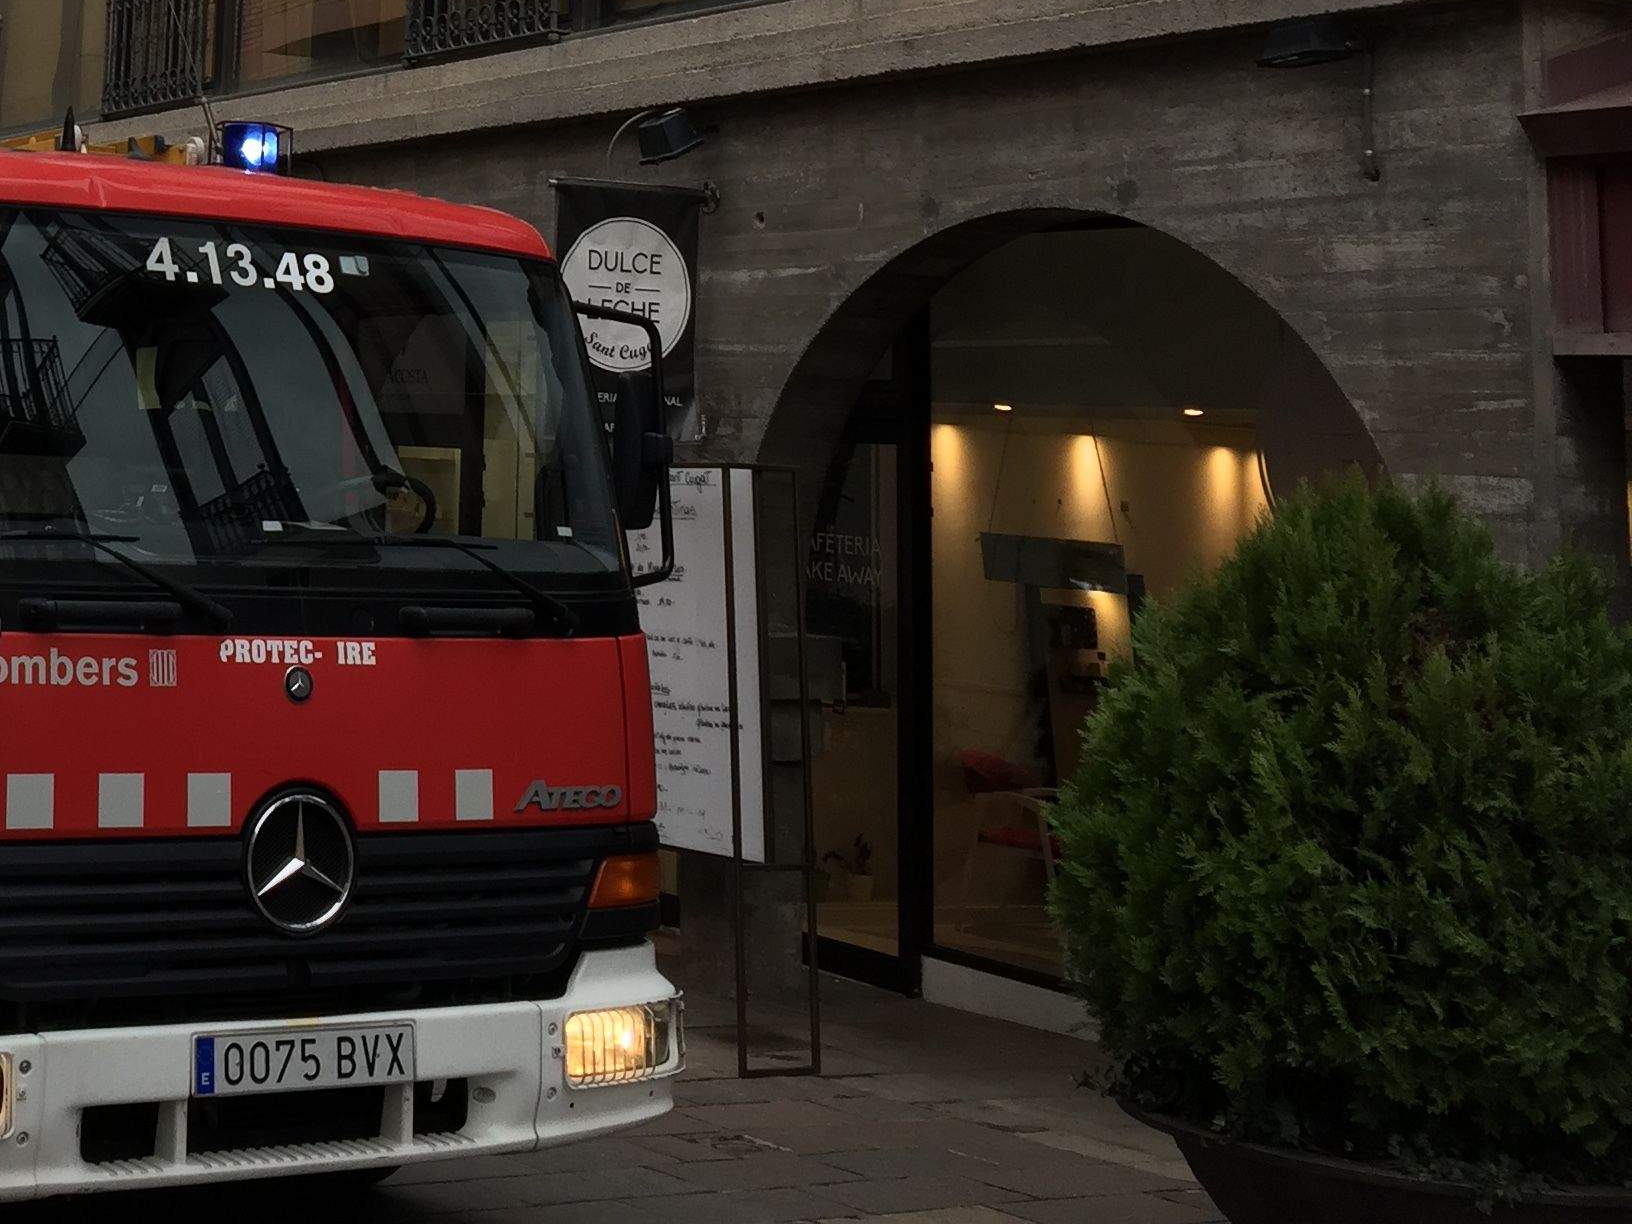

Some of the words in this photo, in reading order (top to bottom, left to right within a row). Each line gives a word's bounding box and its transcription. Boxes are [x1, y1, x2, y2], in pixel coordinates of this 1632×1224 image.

[146, 236, 335, 294] 4.13.48
[587, 249, 662, 275] DULCE
[615, 281, 631, 294] DE
[584, 332, 615, 358] Sant
[837, 563, 881, 587] AWAY
[201, 1072, 210, 1085] E
[224, 1038, 320, 1085] 0075
[337, 1033, 405, 1079] BVX
